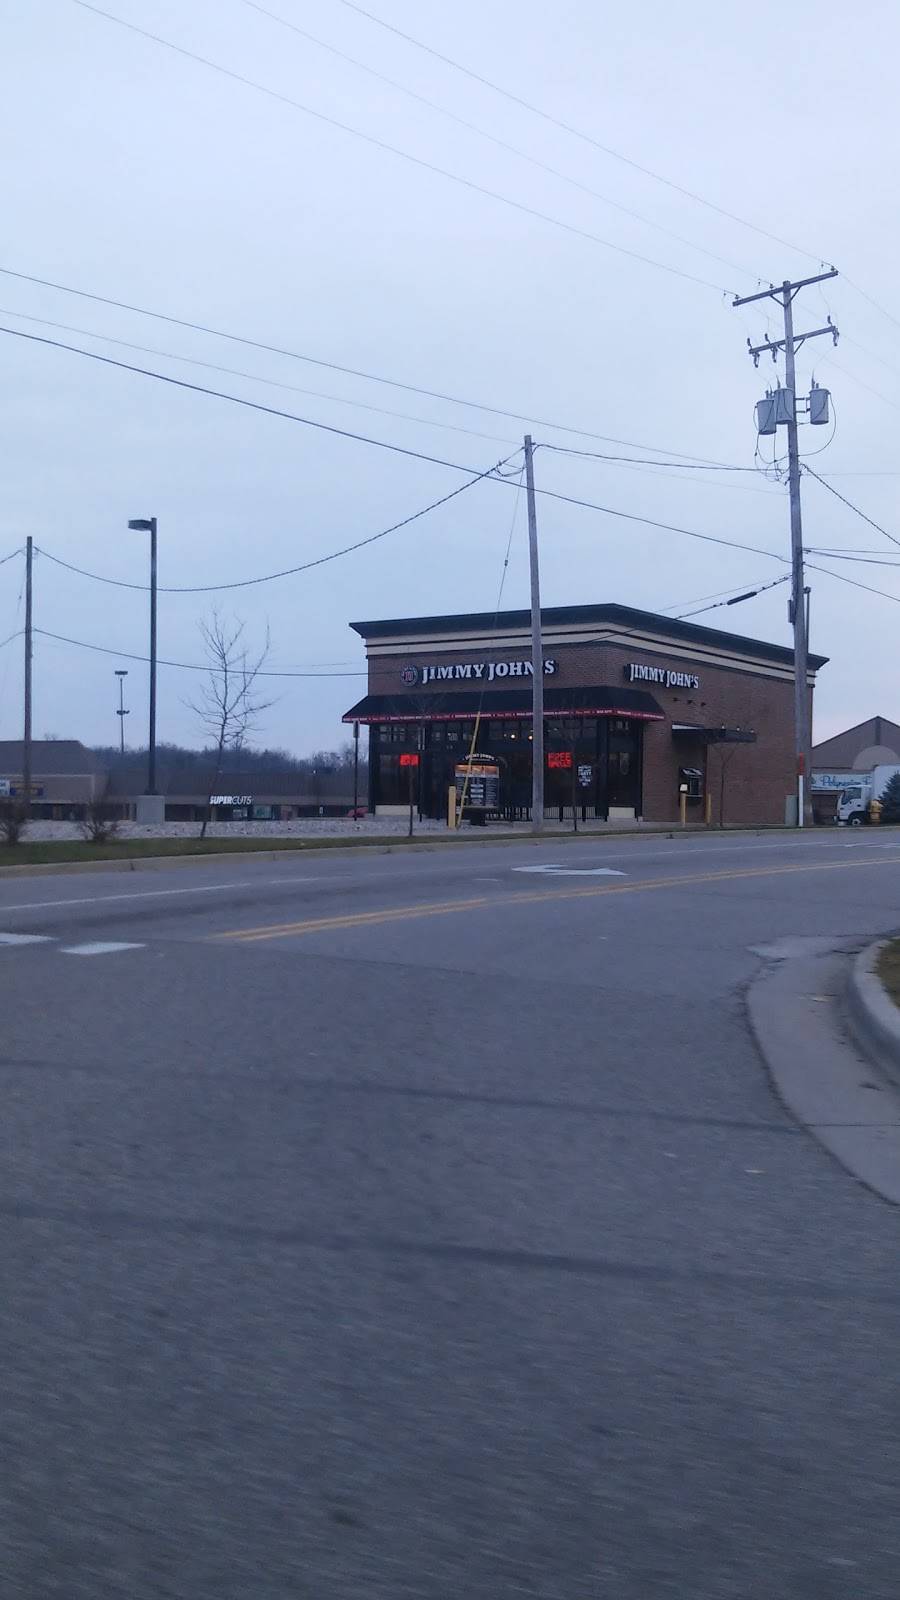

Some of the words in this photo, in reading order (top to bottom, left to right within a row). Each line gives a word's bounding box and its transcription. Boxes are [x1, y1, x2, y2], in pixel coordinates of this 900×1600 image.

[421, 663, 485, 683] JIMMY
[487, 659, 555, 681] JOHNS
[629, 663, 665, 682] JIMMY
[665, 670, 699, 689] JOHN'S
[209, 796, 252, 805] SUPERCUTS
